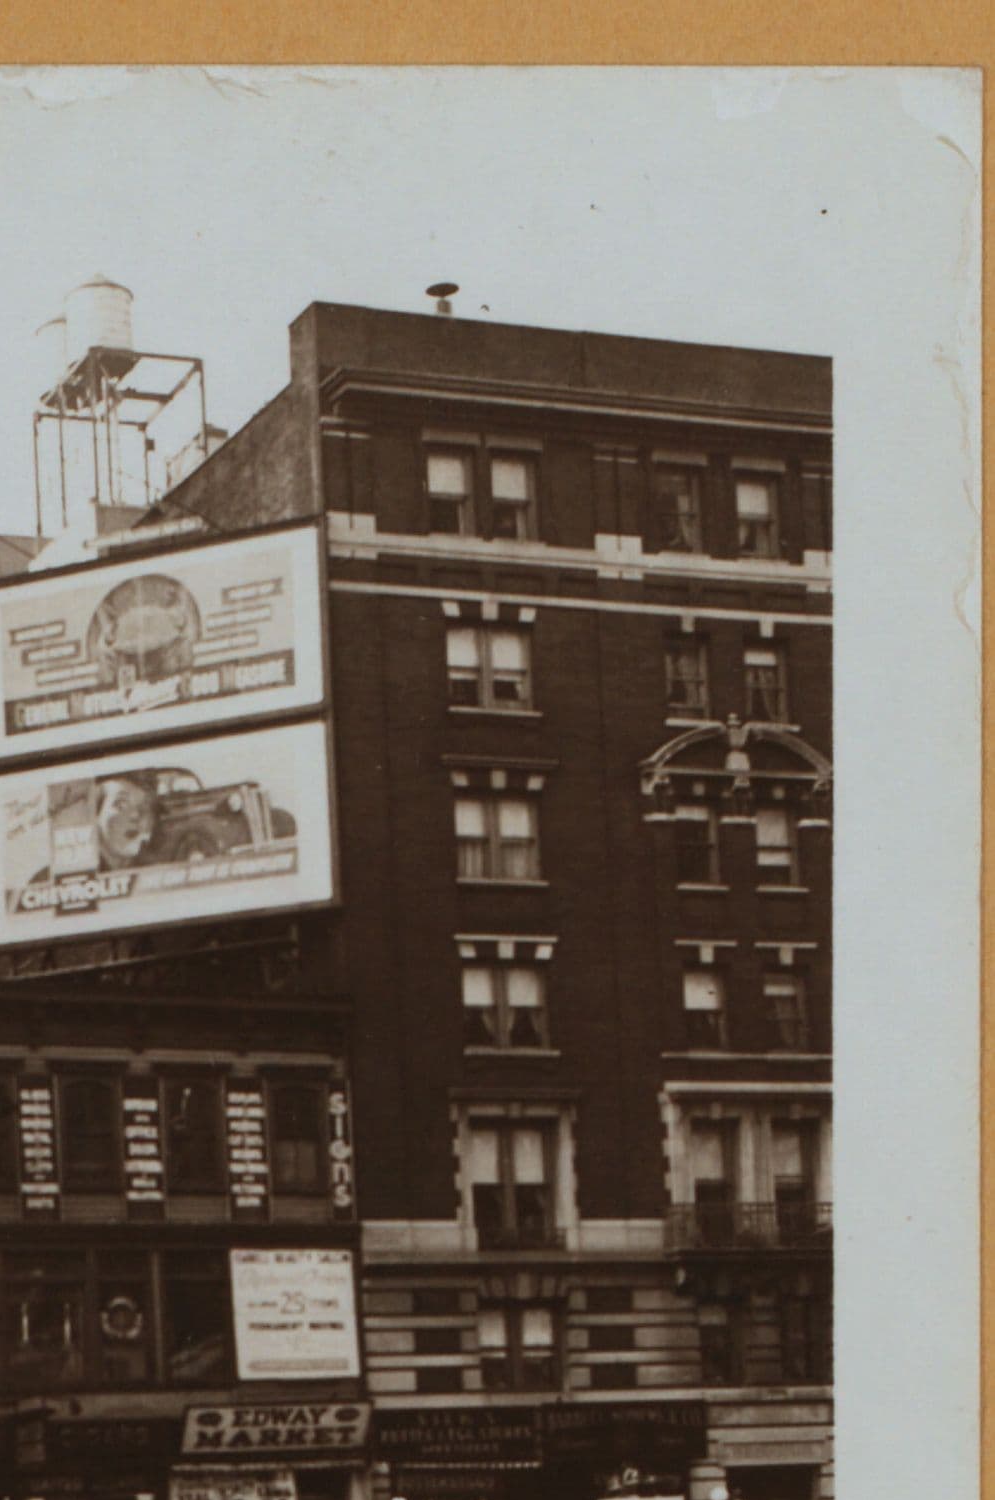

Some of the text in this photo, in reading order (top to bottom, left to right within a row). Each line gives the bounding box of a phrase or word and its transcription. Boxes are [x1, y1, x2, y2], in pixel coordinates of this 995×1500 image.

[21, 876, 131, 909] CHEVROLET
[232, 1406, 328, 1427] EDWAY
[193, 1425, 359, 1448] MARKET
